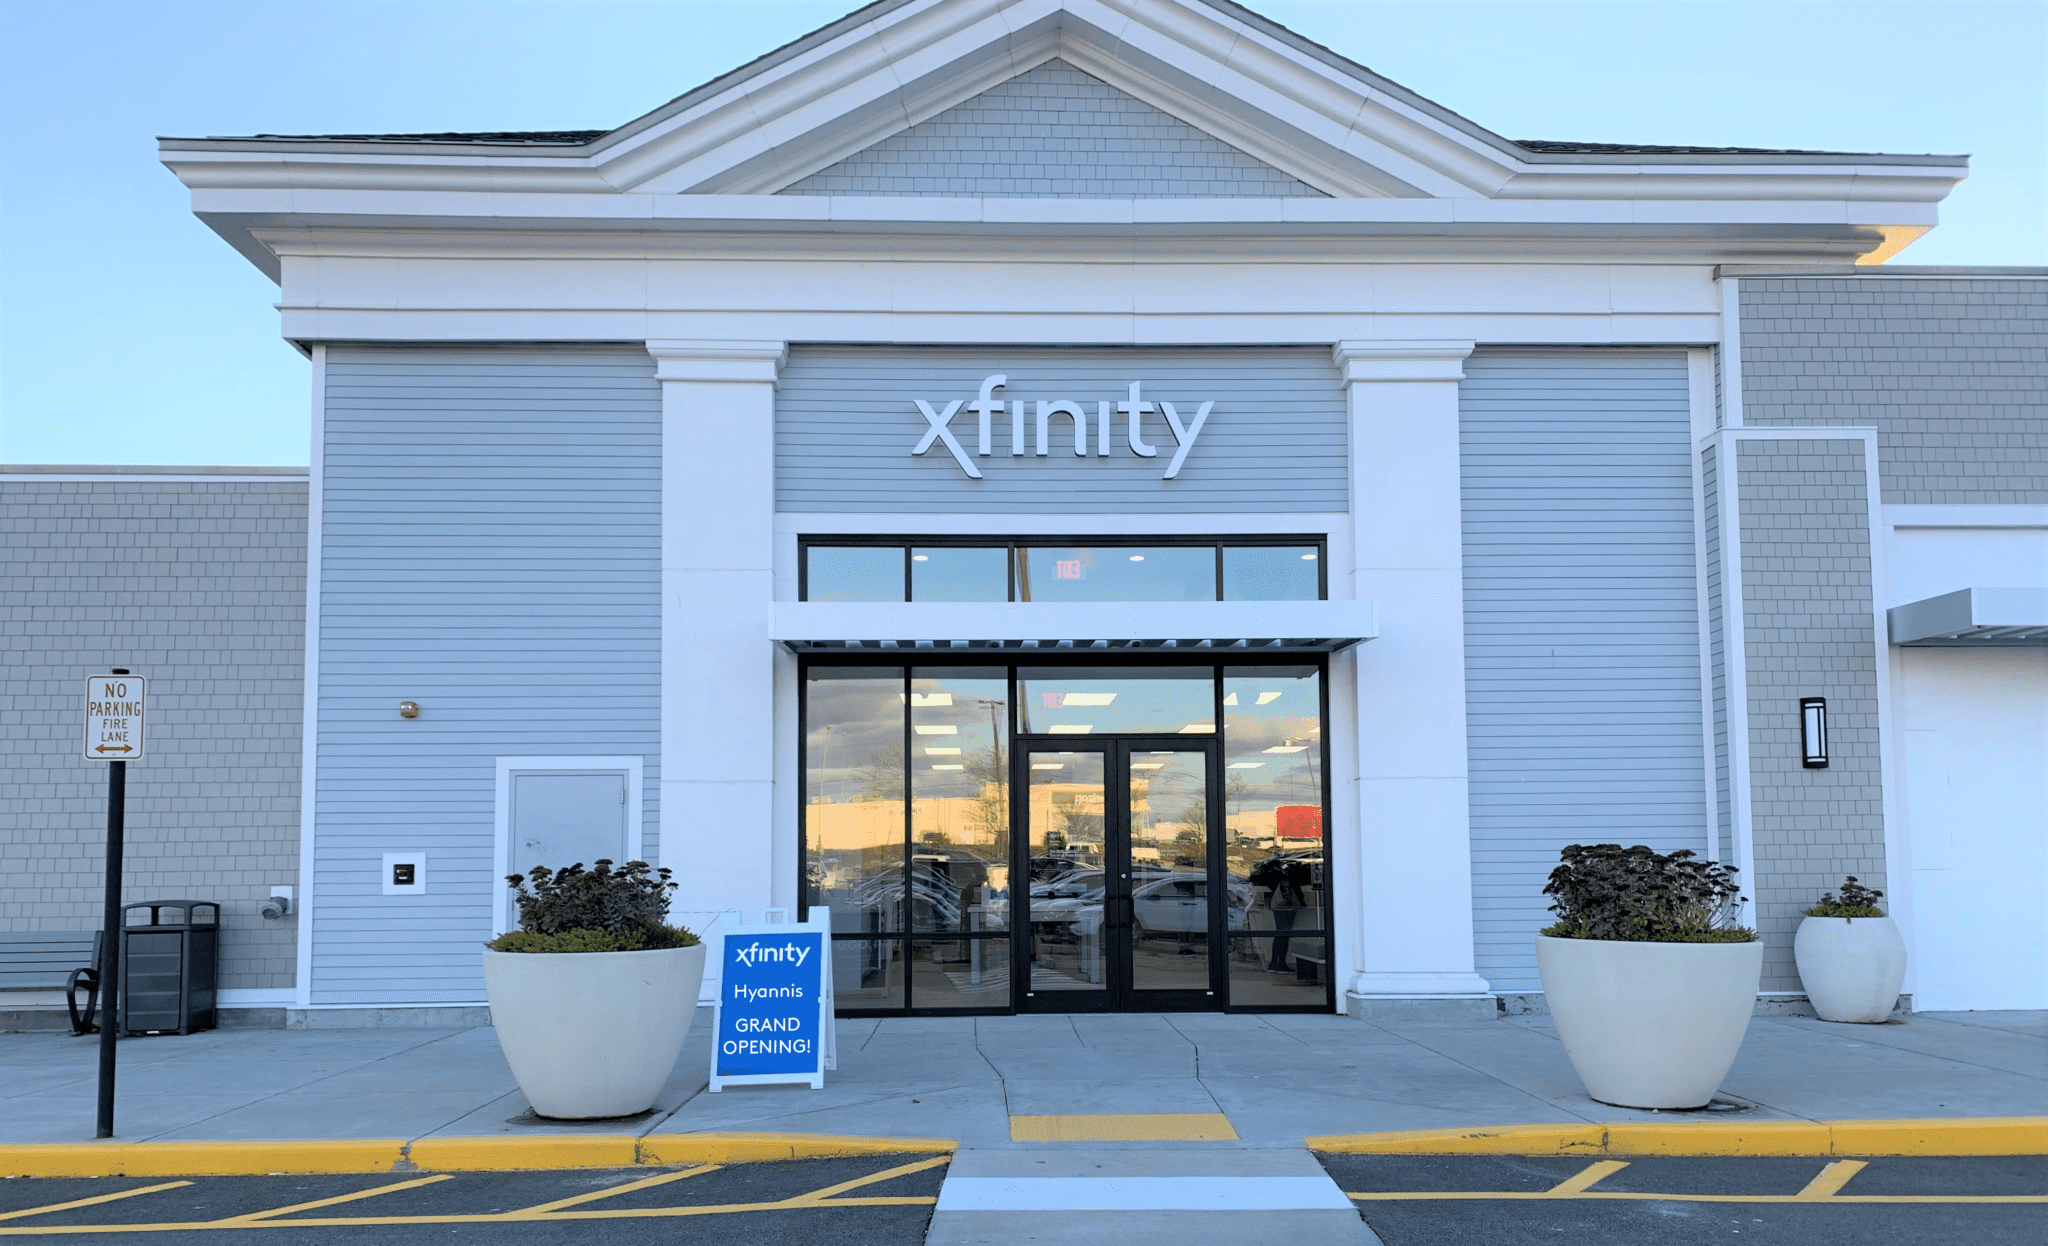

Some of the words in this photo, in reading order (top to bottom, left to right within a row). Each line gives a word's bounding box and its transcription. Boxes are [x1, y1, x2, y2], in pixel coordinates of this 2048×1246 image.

[910, 374, 1215, 480] xfinity
[105, 683, 127, 698] NO
[89, 701, 141, 717] PARKING
[103, 719, 128, 729] FIRE
[101, 732, 129, 742] LANE
[735, 942, 811, 967] xfinity
[734, 984, 803, 1003] Hyannis
[735, 1017, 801, 1033] GRAND
[723, 1039, 811, 1055] OPENING!
